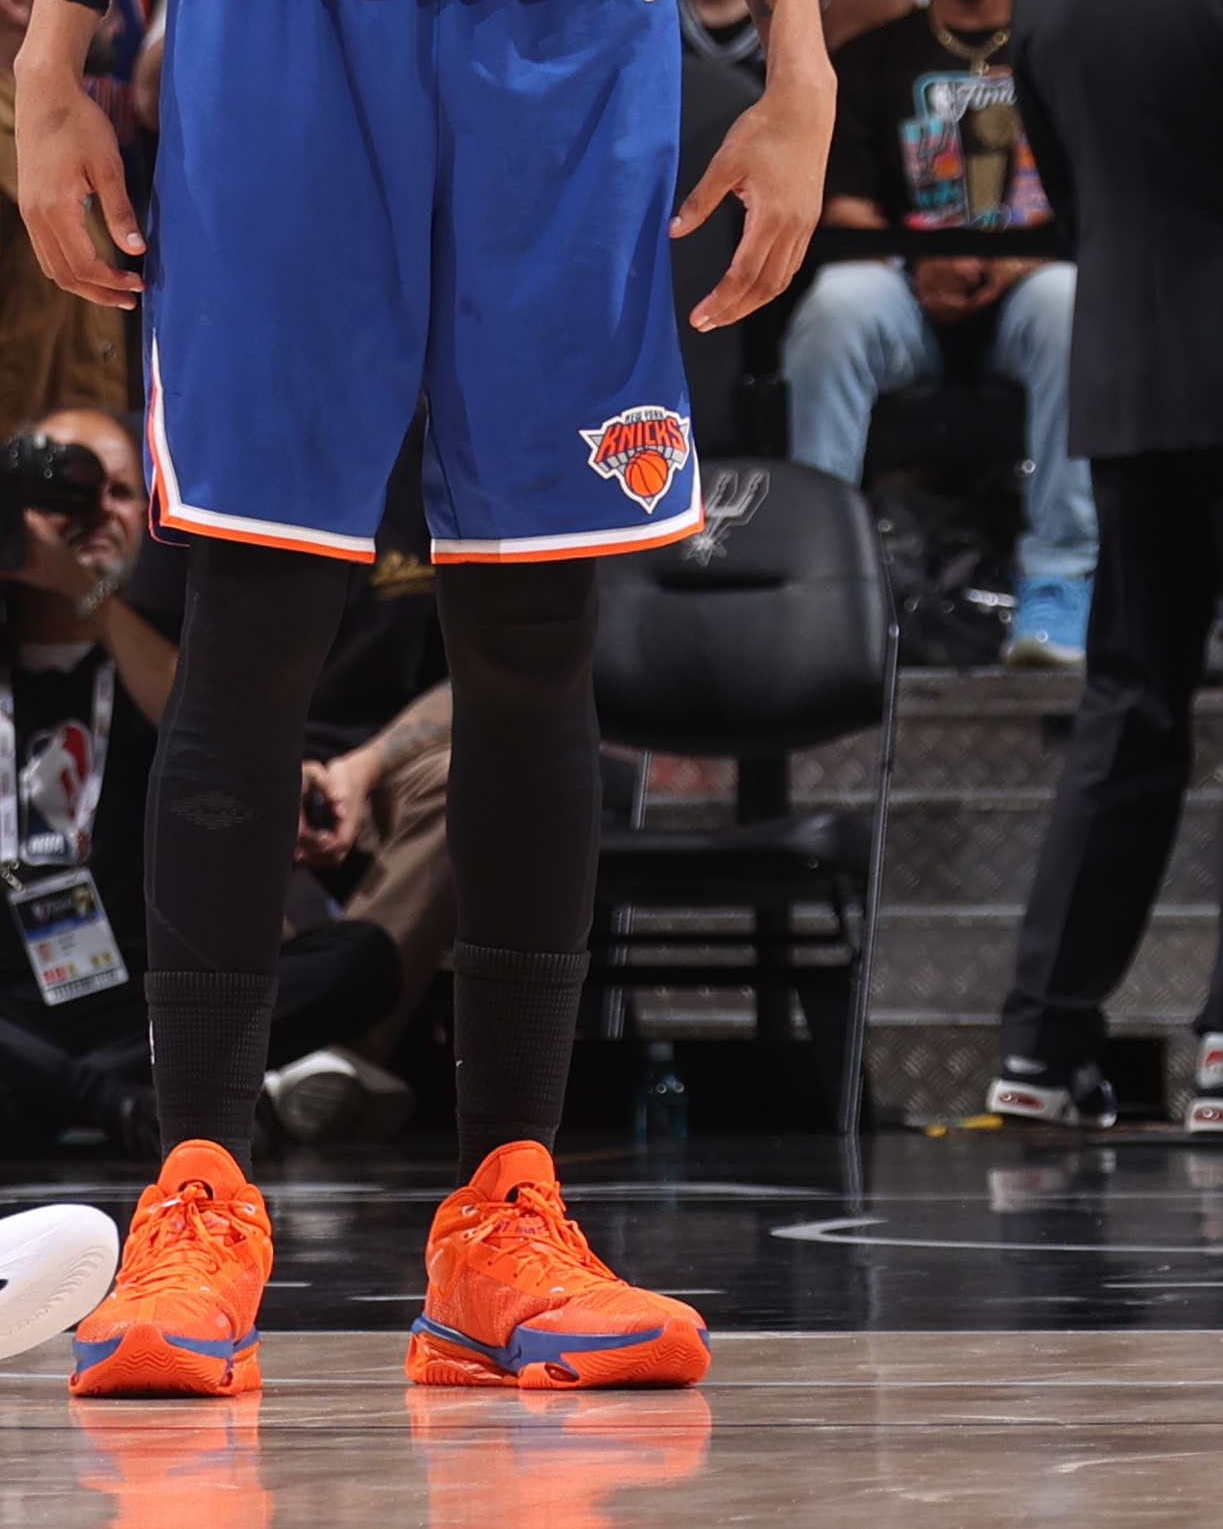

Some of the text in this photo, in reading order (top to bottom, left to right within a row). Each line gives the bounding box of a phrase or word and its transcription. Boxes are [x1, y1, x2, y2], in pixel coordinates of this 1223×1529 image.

[625, 410, 665, 424] NEW YORK
[594, 415, 687, 463] KNICKS
